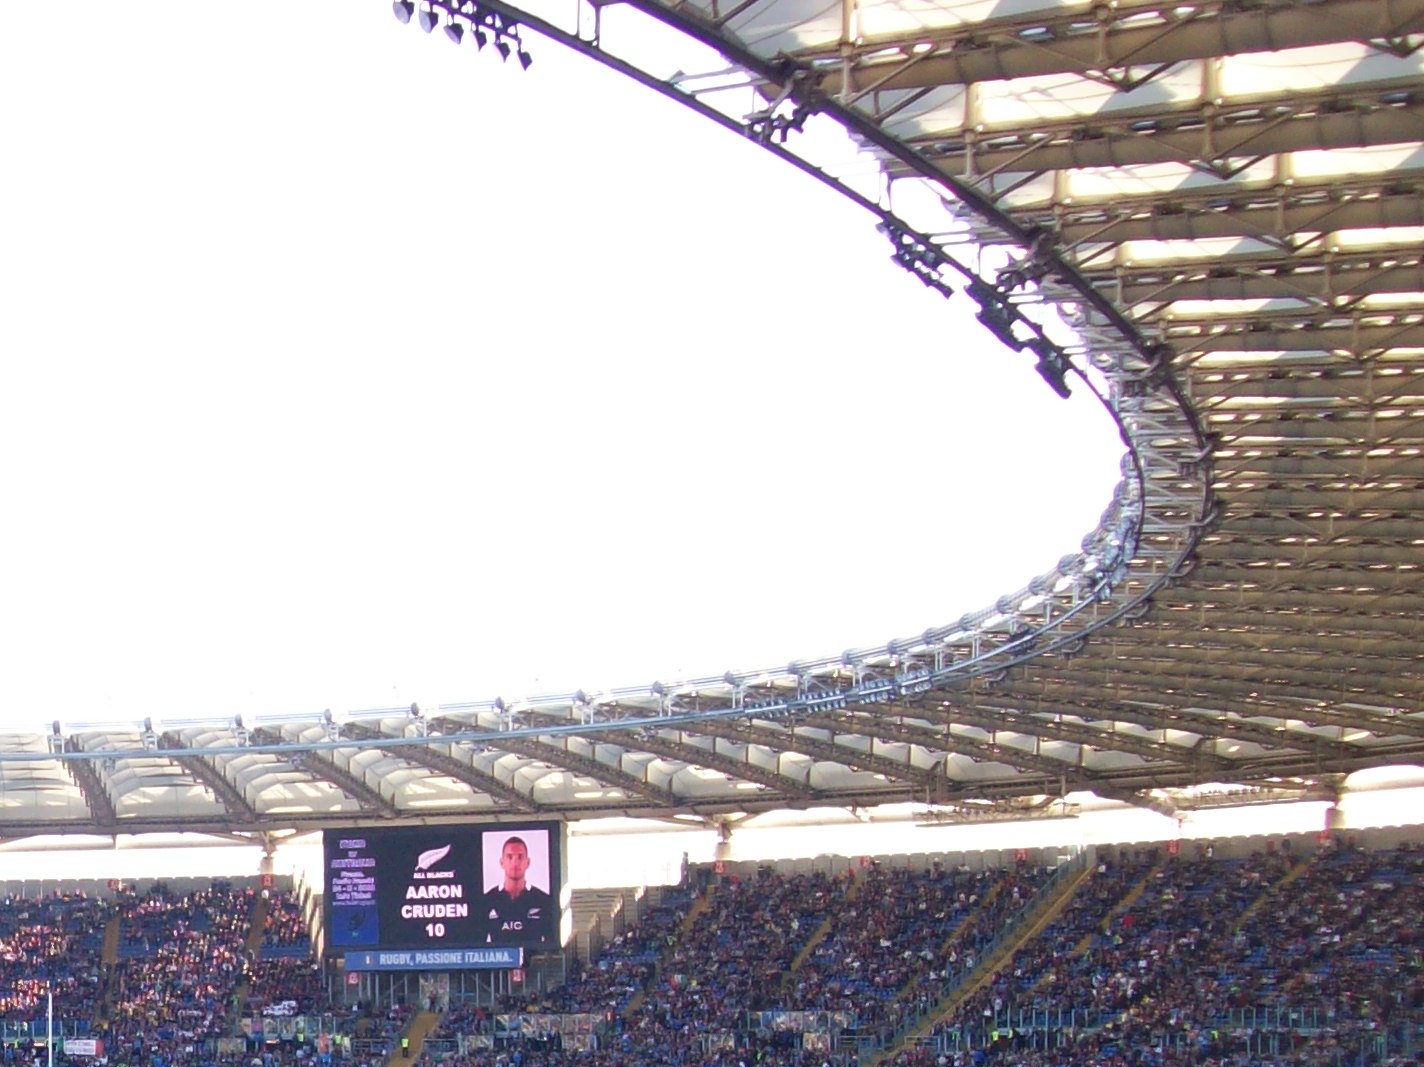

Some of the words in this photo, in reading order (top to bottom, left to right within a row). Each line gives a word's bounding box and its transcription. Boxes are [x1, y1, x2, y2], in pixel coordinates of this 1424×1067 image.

[405, 884, 462, 899] AARON
[401, 903, 467, 919] CRUDEN
[425, 923, 445, 937] 10
[379, 953, 414, 966] RUGBY,
[415, 952, 462, 965] PASSIONE
[464, 951, 513, 963] ITALIANA.
